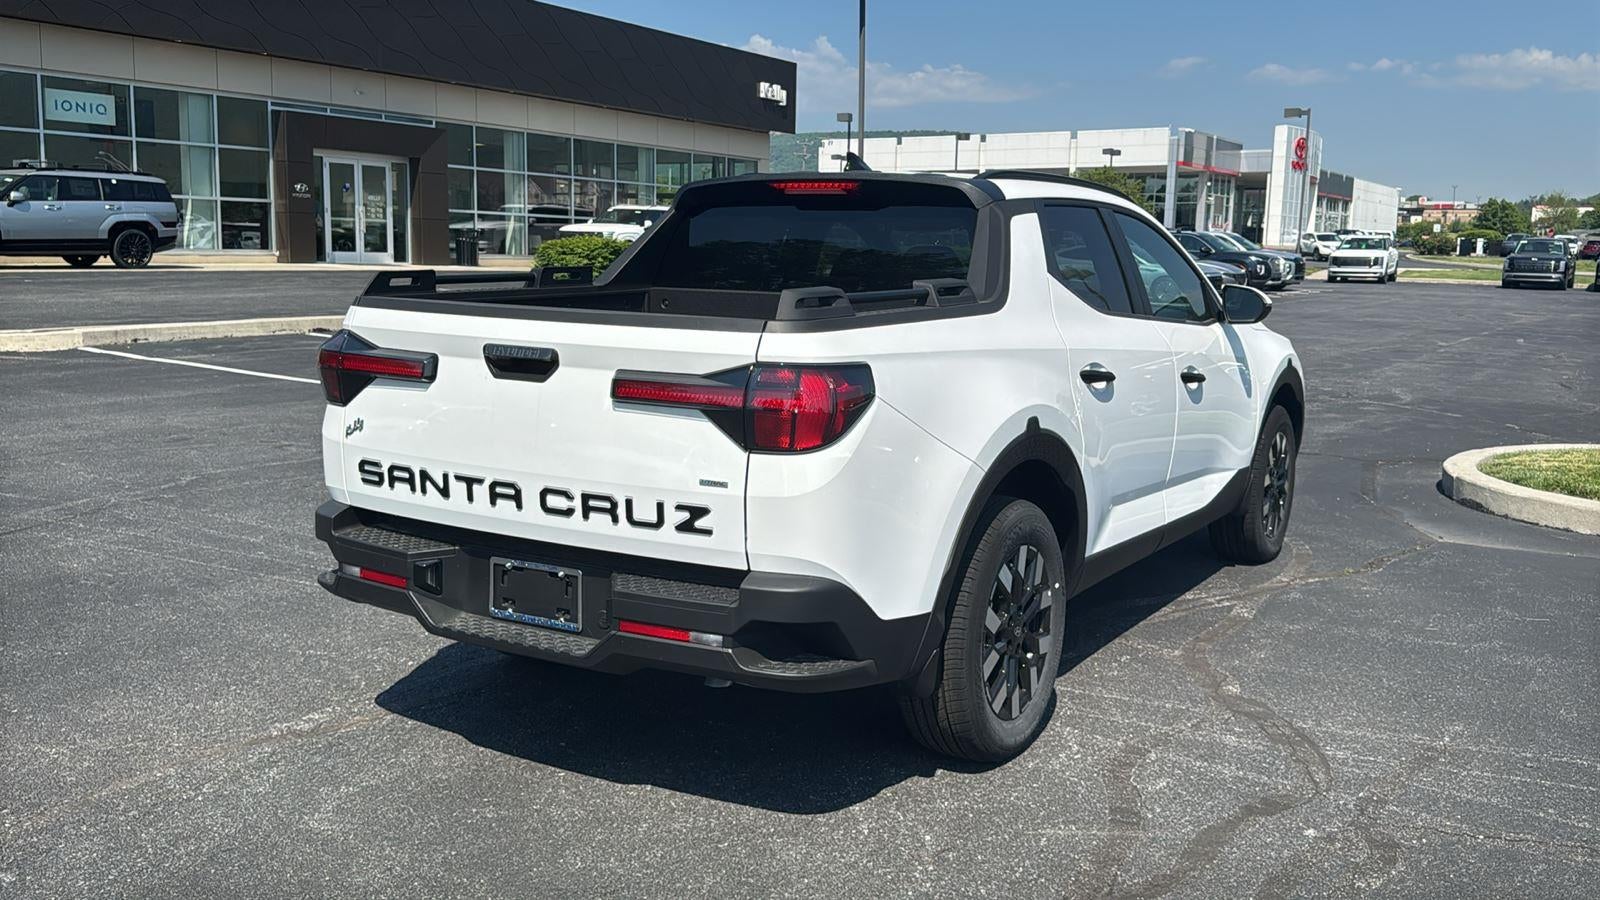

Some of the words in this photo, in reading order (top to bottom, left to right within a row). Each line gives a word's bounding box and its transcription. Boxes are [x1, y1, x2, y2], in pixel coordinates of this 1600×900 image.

[758, 81, 787, 106] Kelly
[54, 99, 107, 115] IONIQ
[345, 417, 364, 440] Kelly
[358, 457, 523, 512] SANTA
[539, 485, 714, 537] CRUZ
